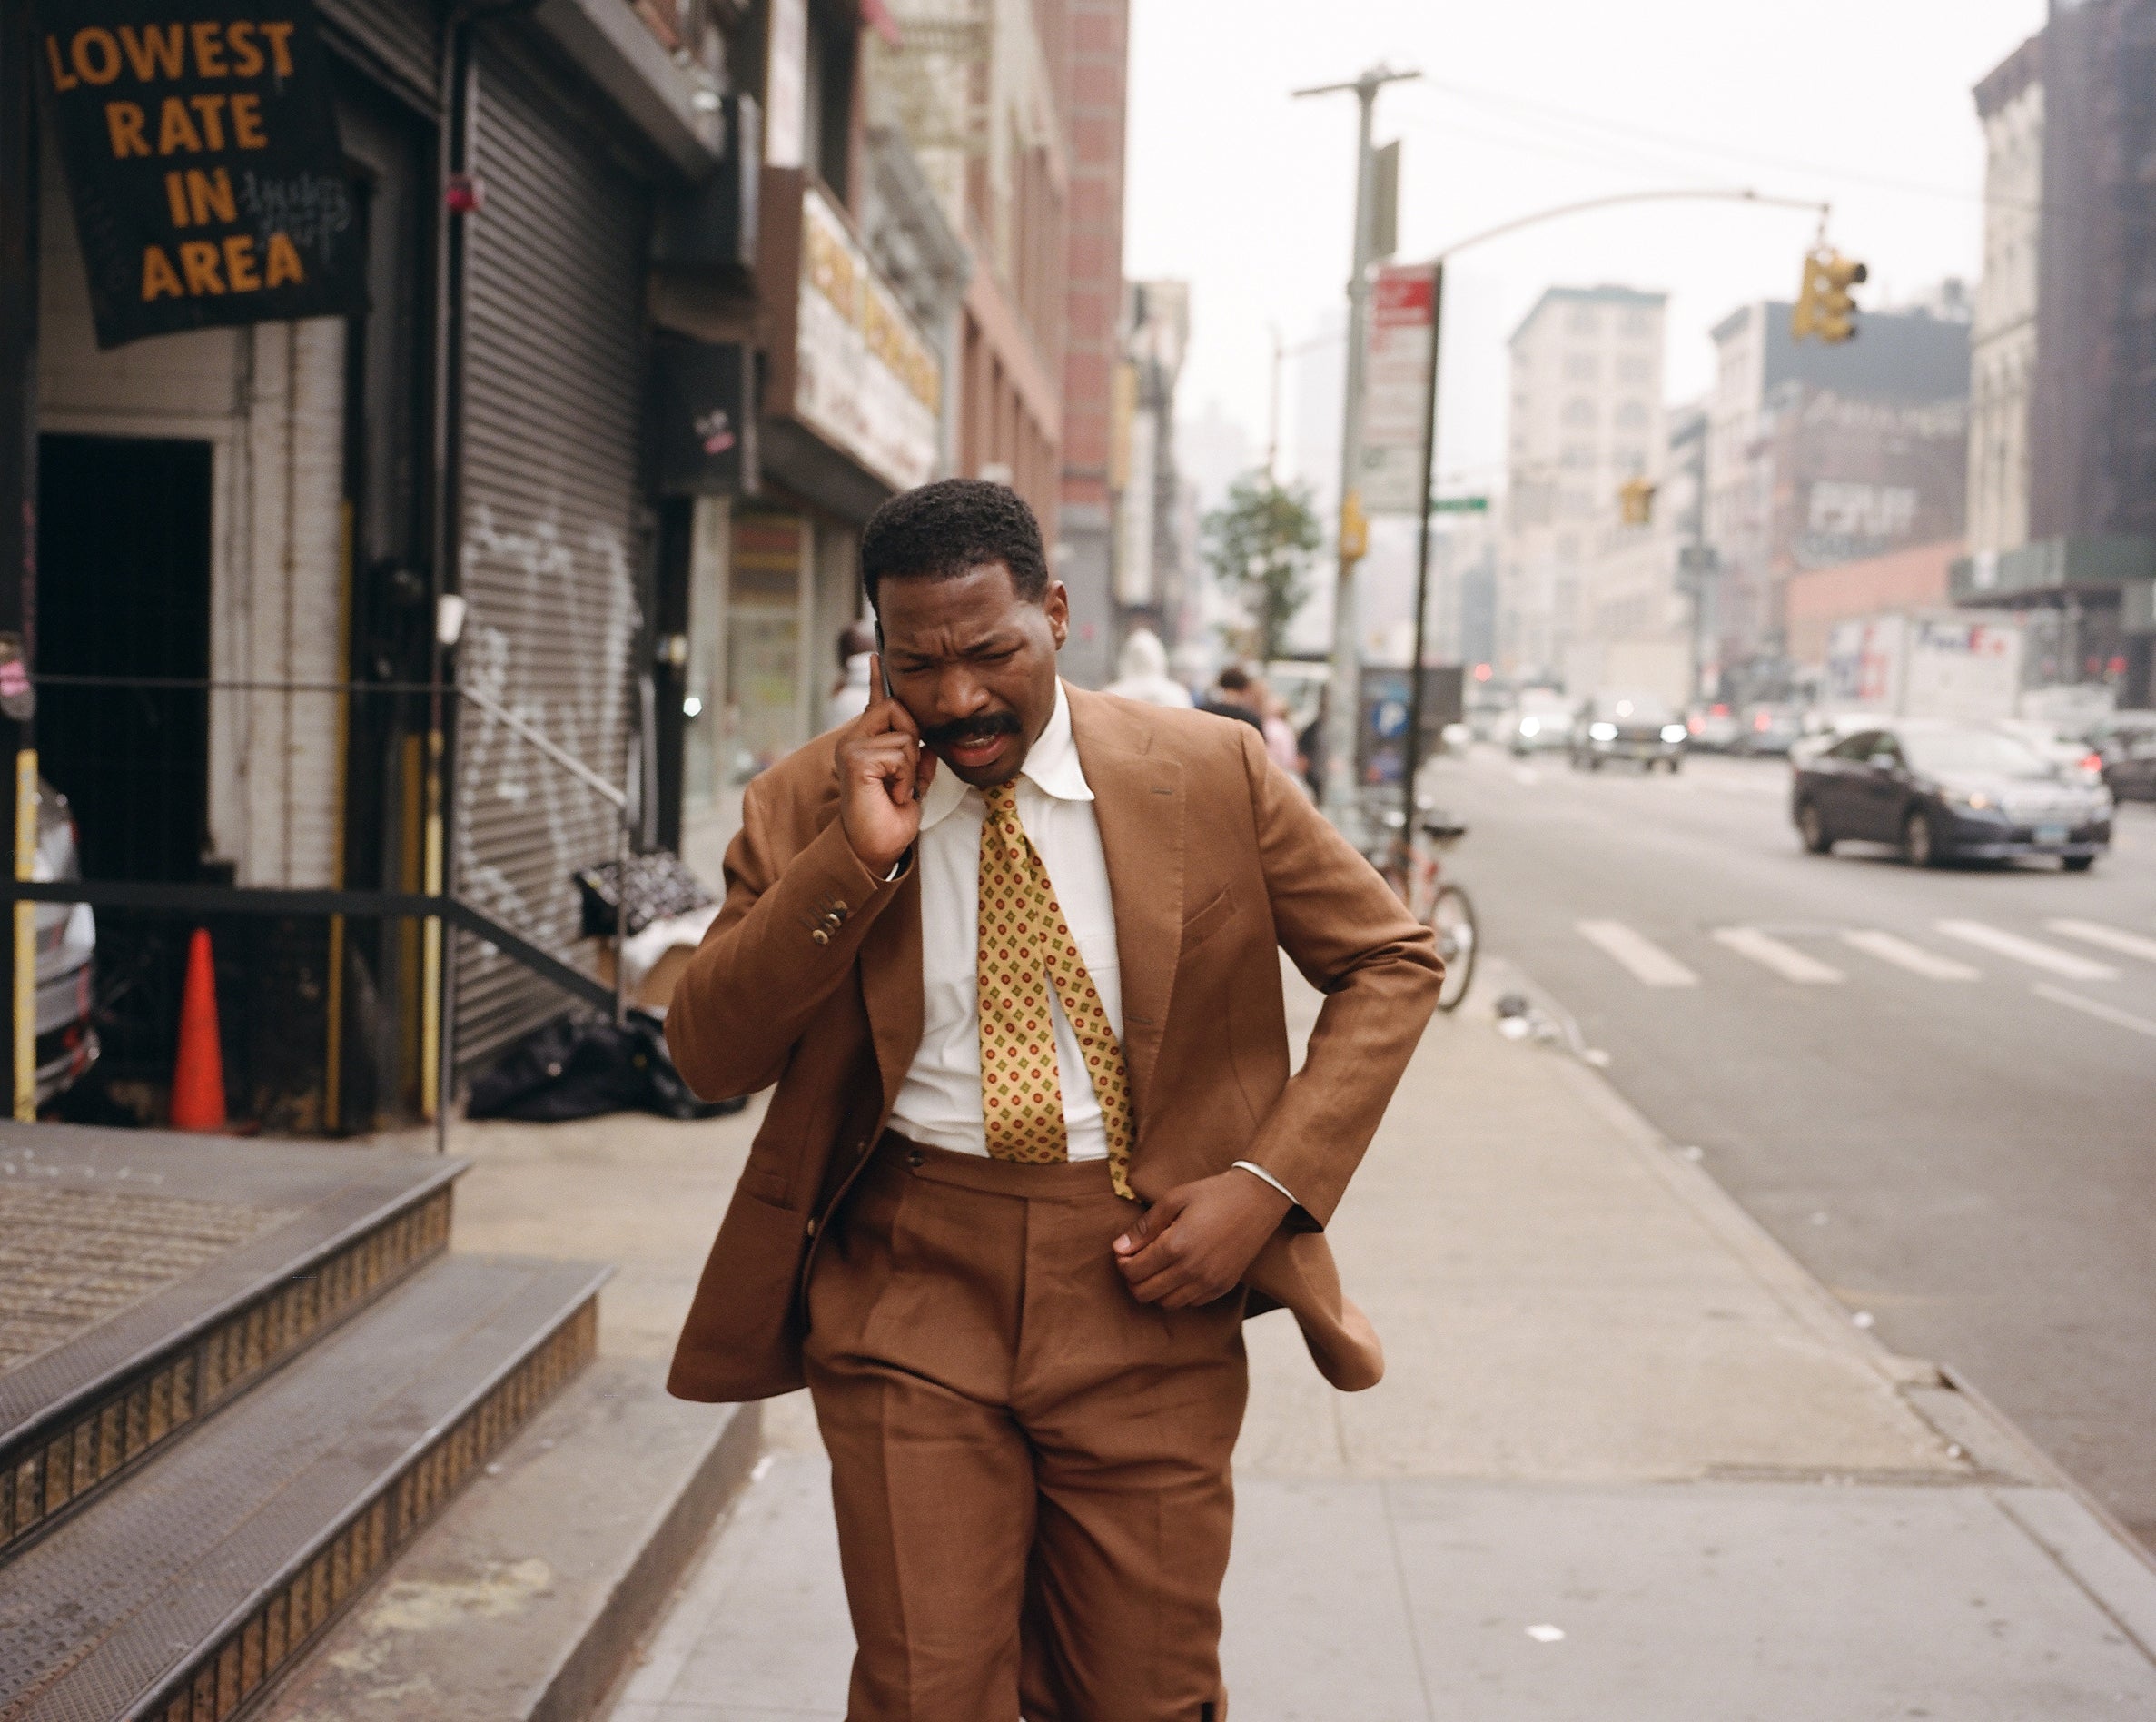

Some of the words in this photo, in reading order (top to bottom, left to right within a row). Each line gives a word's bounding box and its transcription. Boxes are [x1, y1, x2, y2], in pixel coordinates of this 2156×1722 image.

[46, 20, 295, 91] LOWEST
[104, 93, 268, 159] RATE
[163, 166, 238, 227] IN
[140, 231, 305, 302] AREA
